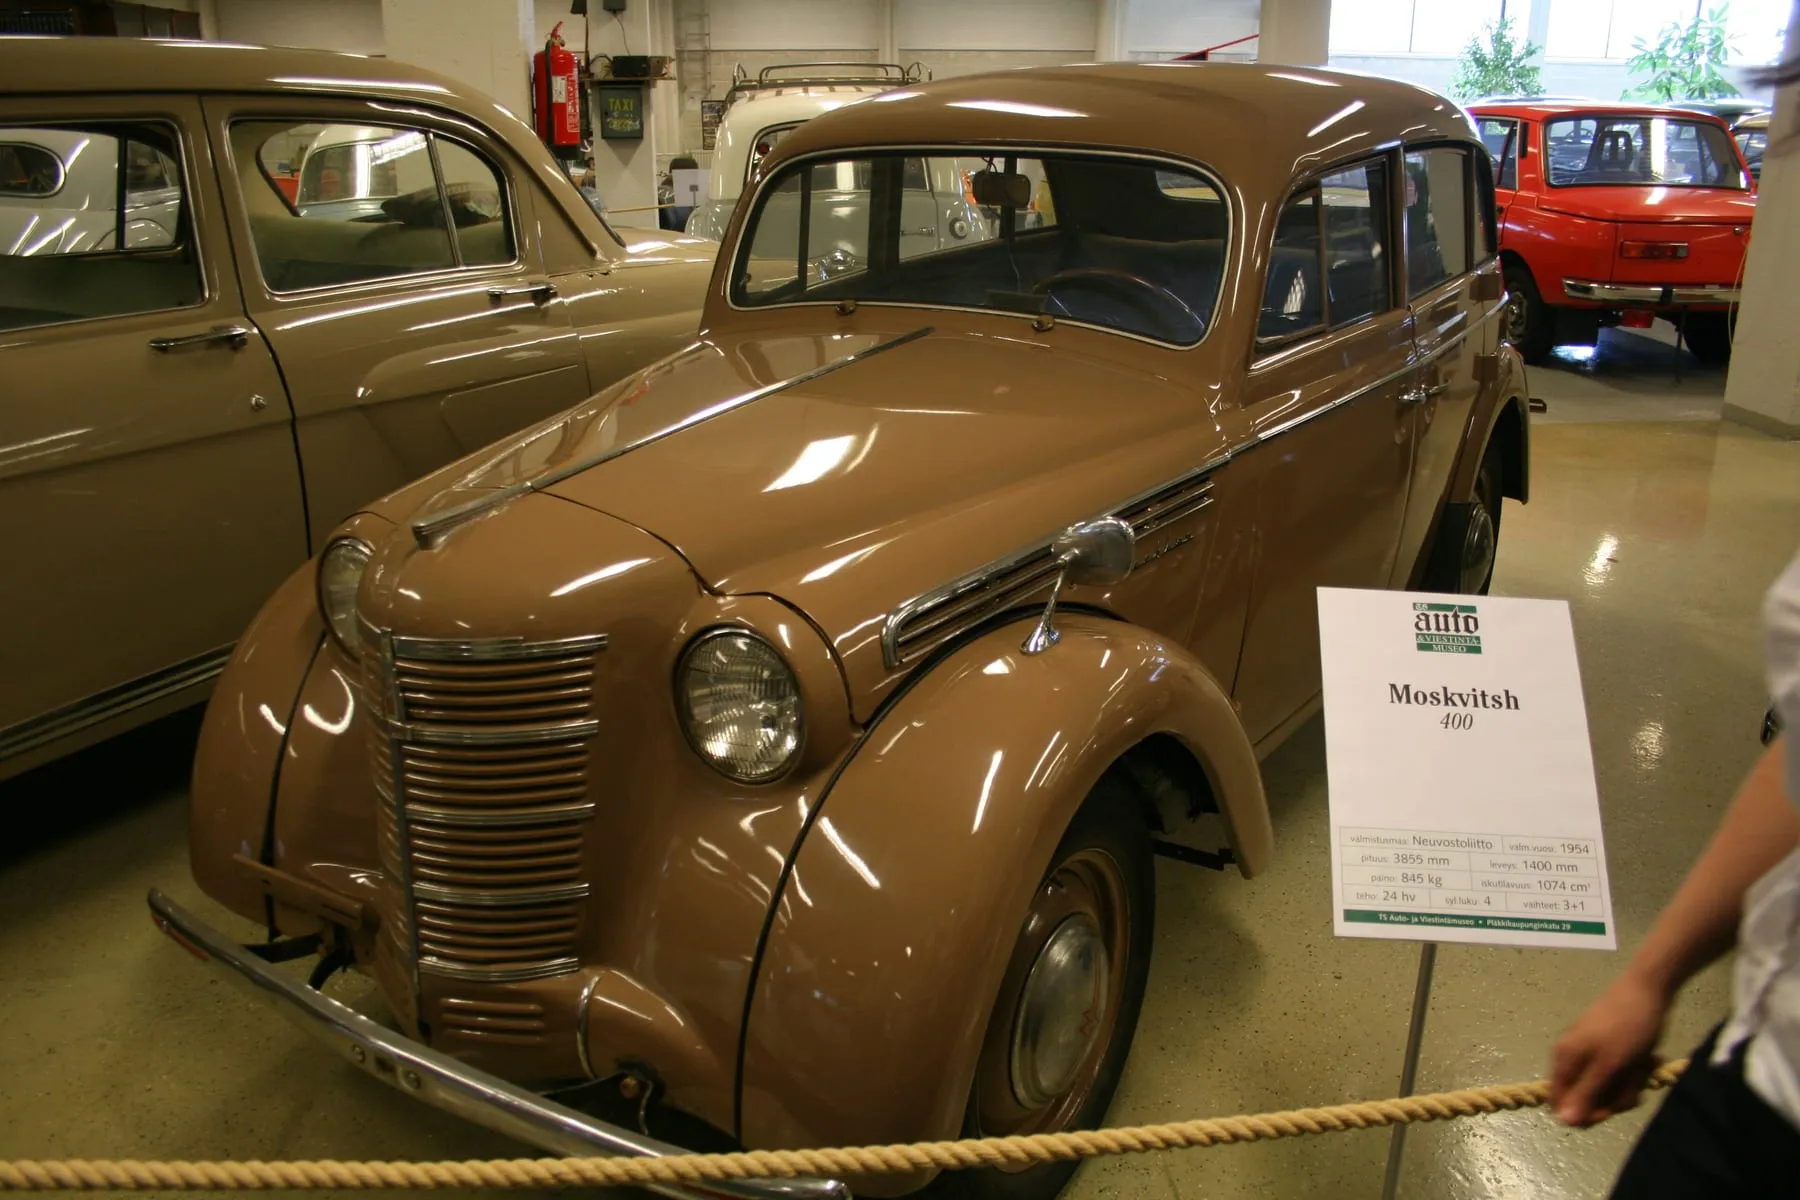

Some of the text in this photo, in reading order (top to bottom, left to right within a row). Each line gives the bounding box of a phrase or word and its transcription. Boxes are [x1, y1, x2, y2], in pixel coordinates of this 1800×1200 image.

[608, 97, 633, 112] TAXI
[1414, 606, 1479, 634] auto
[1432, 644, 1467, 653] MUSEO
[1389, 683, 1520, 710] Moskvitsh
[1440, 712, 1473, 730] 400
[1412, 836, 1493, 850] Neuvostoliitto
[1560, 843, 1589, 854] 1954
[1393, 853, 1424, 865] 3855
[1427, 856, 1450, 866] mm
[1523, 860, 1552, 872] 1400
[1556, 863, 1578, 872] mm
[1401, 872, 1424, 884] 845
[1428, 874, 1442, 887] kg
[1537, 880, 1566, 891] 1074
[1383, 890, 1397, 901] 24
[1401, 891, 1416, 902] hv
[1484, 895, 1491, 906] 4
[1563, 900, 1585, 911] 3+1
[1389, 914, 1410, 922] Auto-
[1411, 915, 1418, 923] ja
[1420, 915, 1474, 925] Viestintämuseo
[1561, 922, 1571, 930] 29
